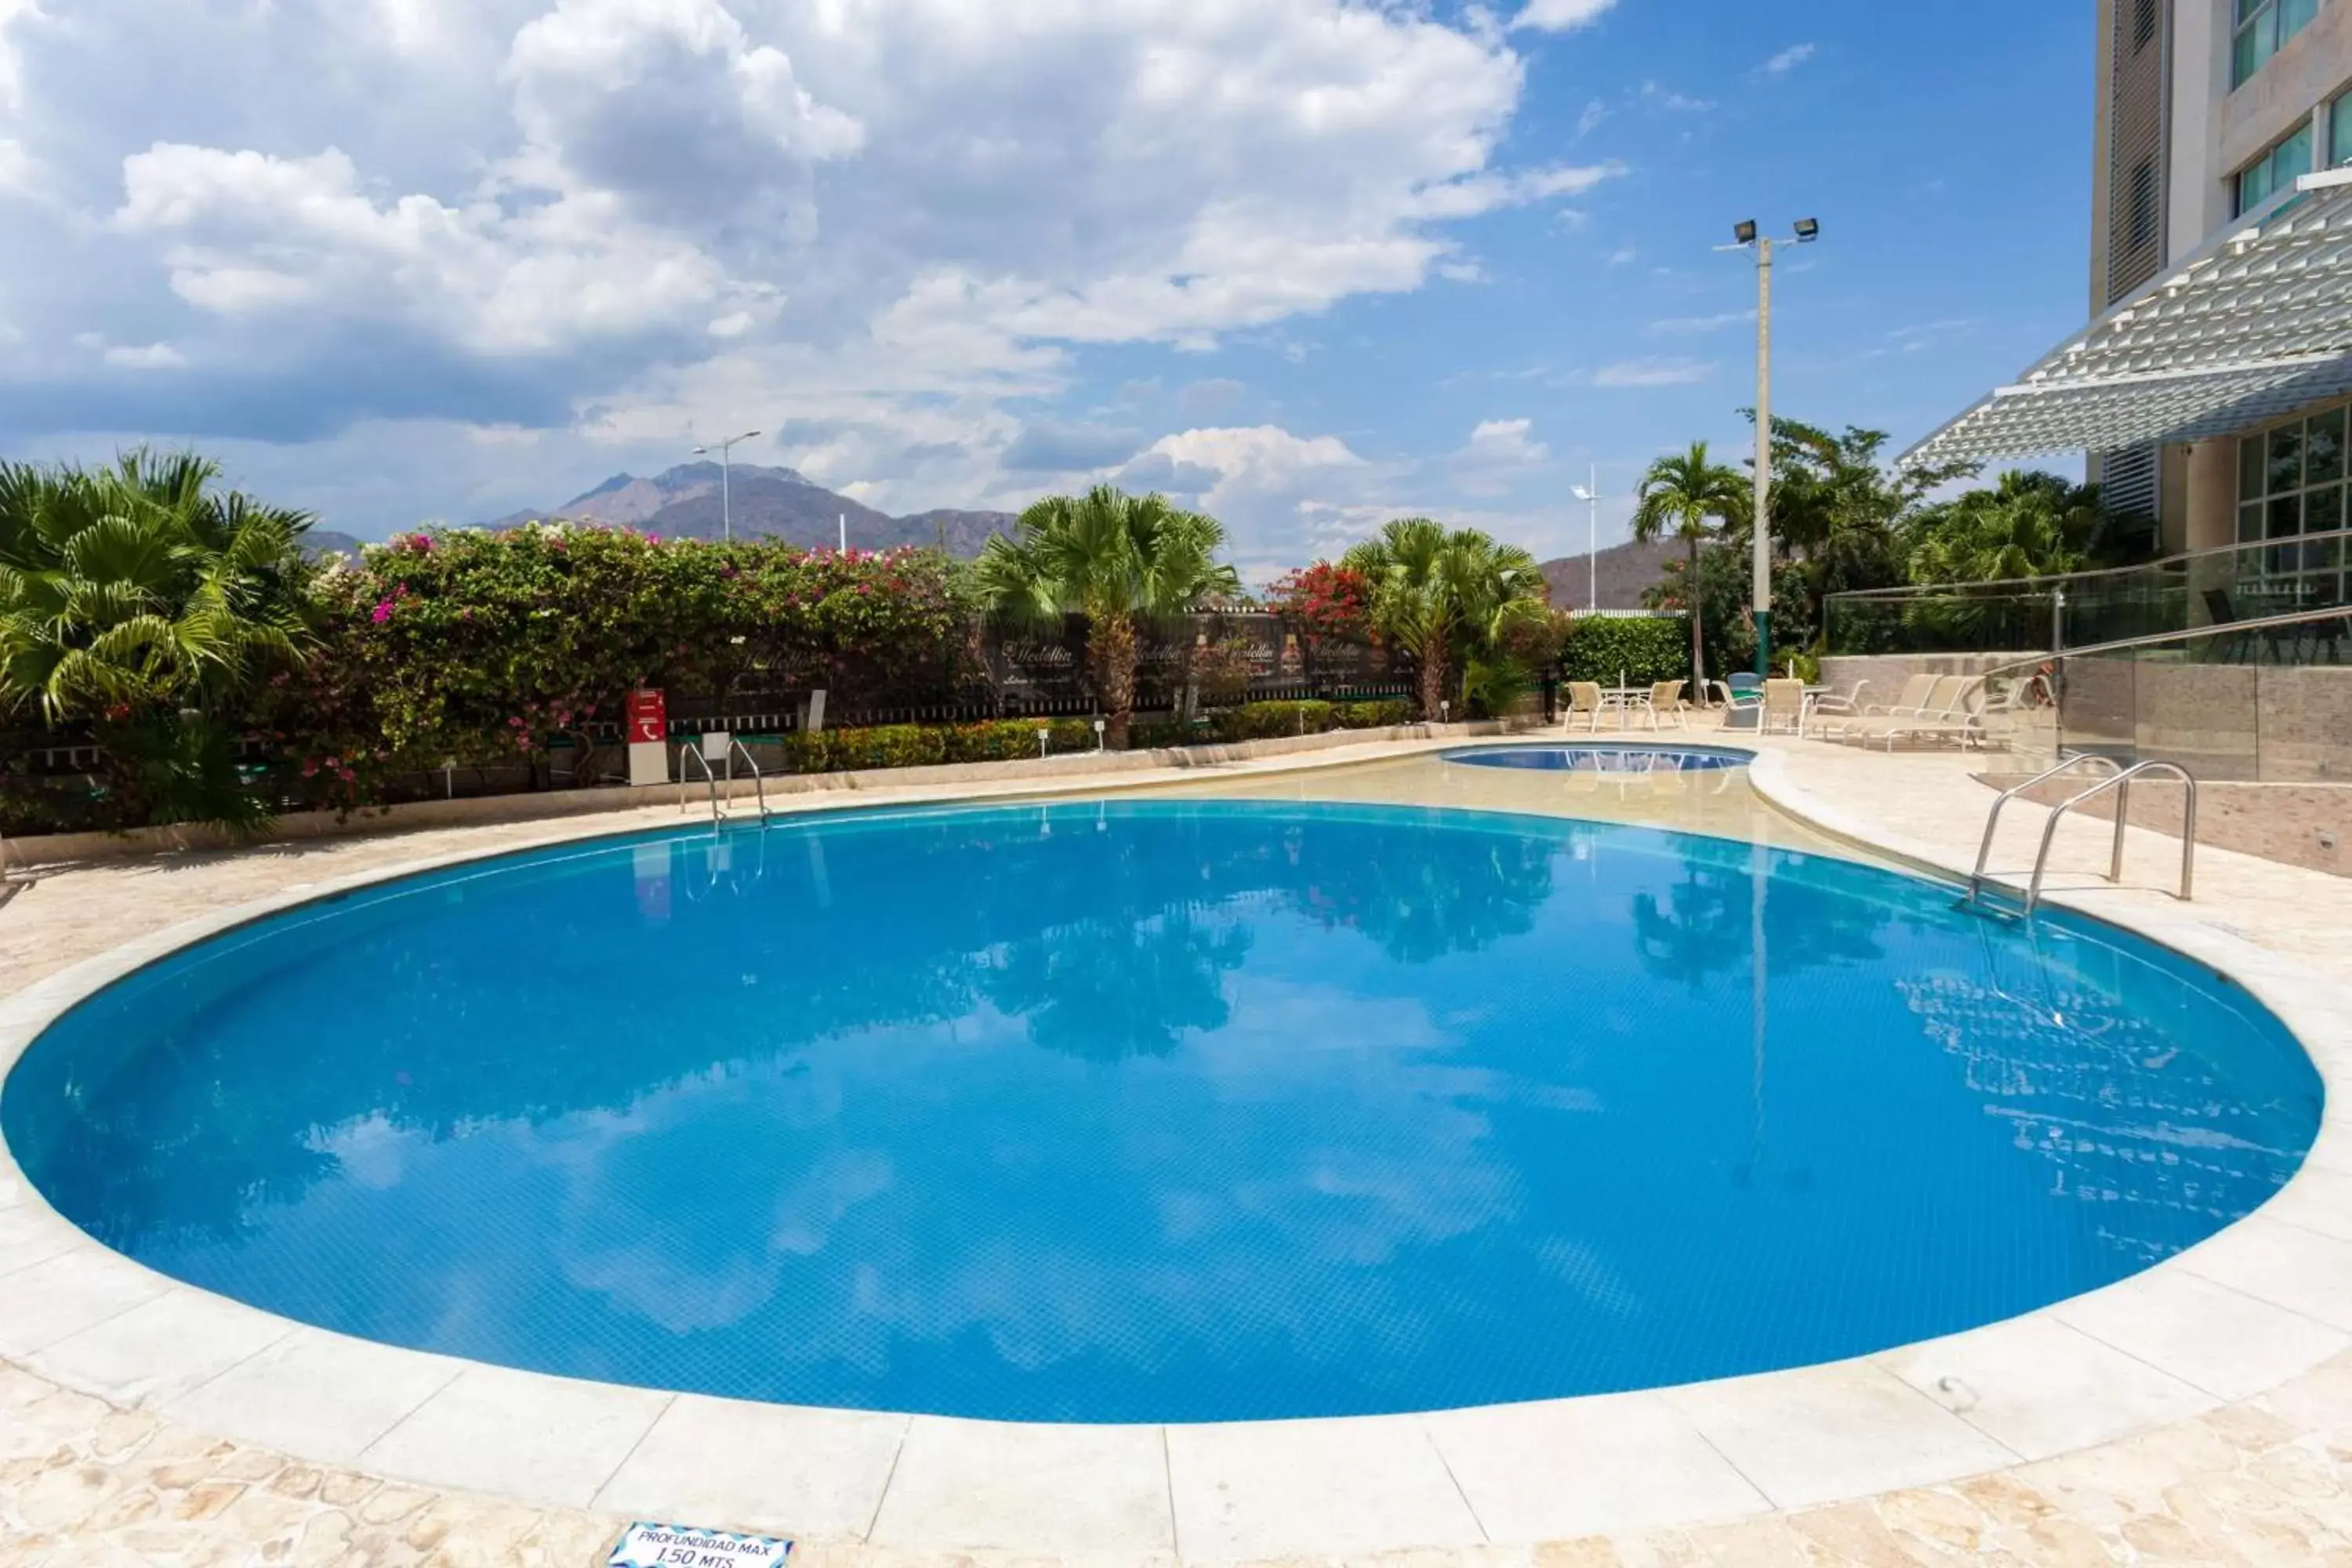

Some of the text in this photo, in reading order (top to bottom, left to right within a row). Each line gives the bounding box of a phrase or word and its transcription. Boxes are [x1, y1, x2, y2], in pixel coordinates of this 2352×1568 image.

[638, 1531, 771, 1555] PROFUNDIDAD MAX
[656, 1547, 735, 1568] 1.50 MTS
